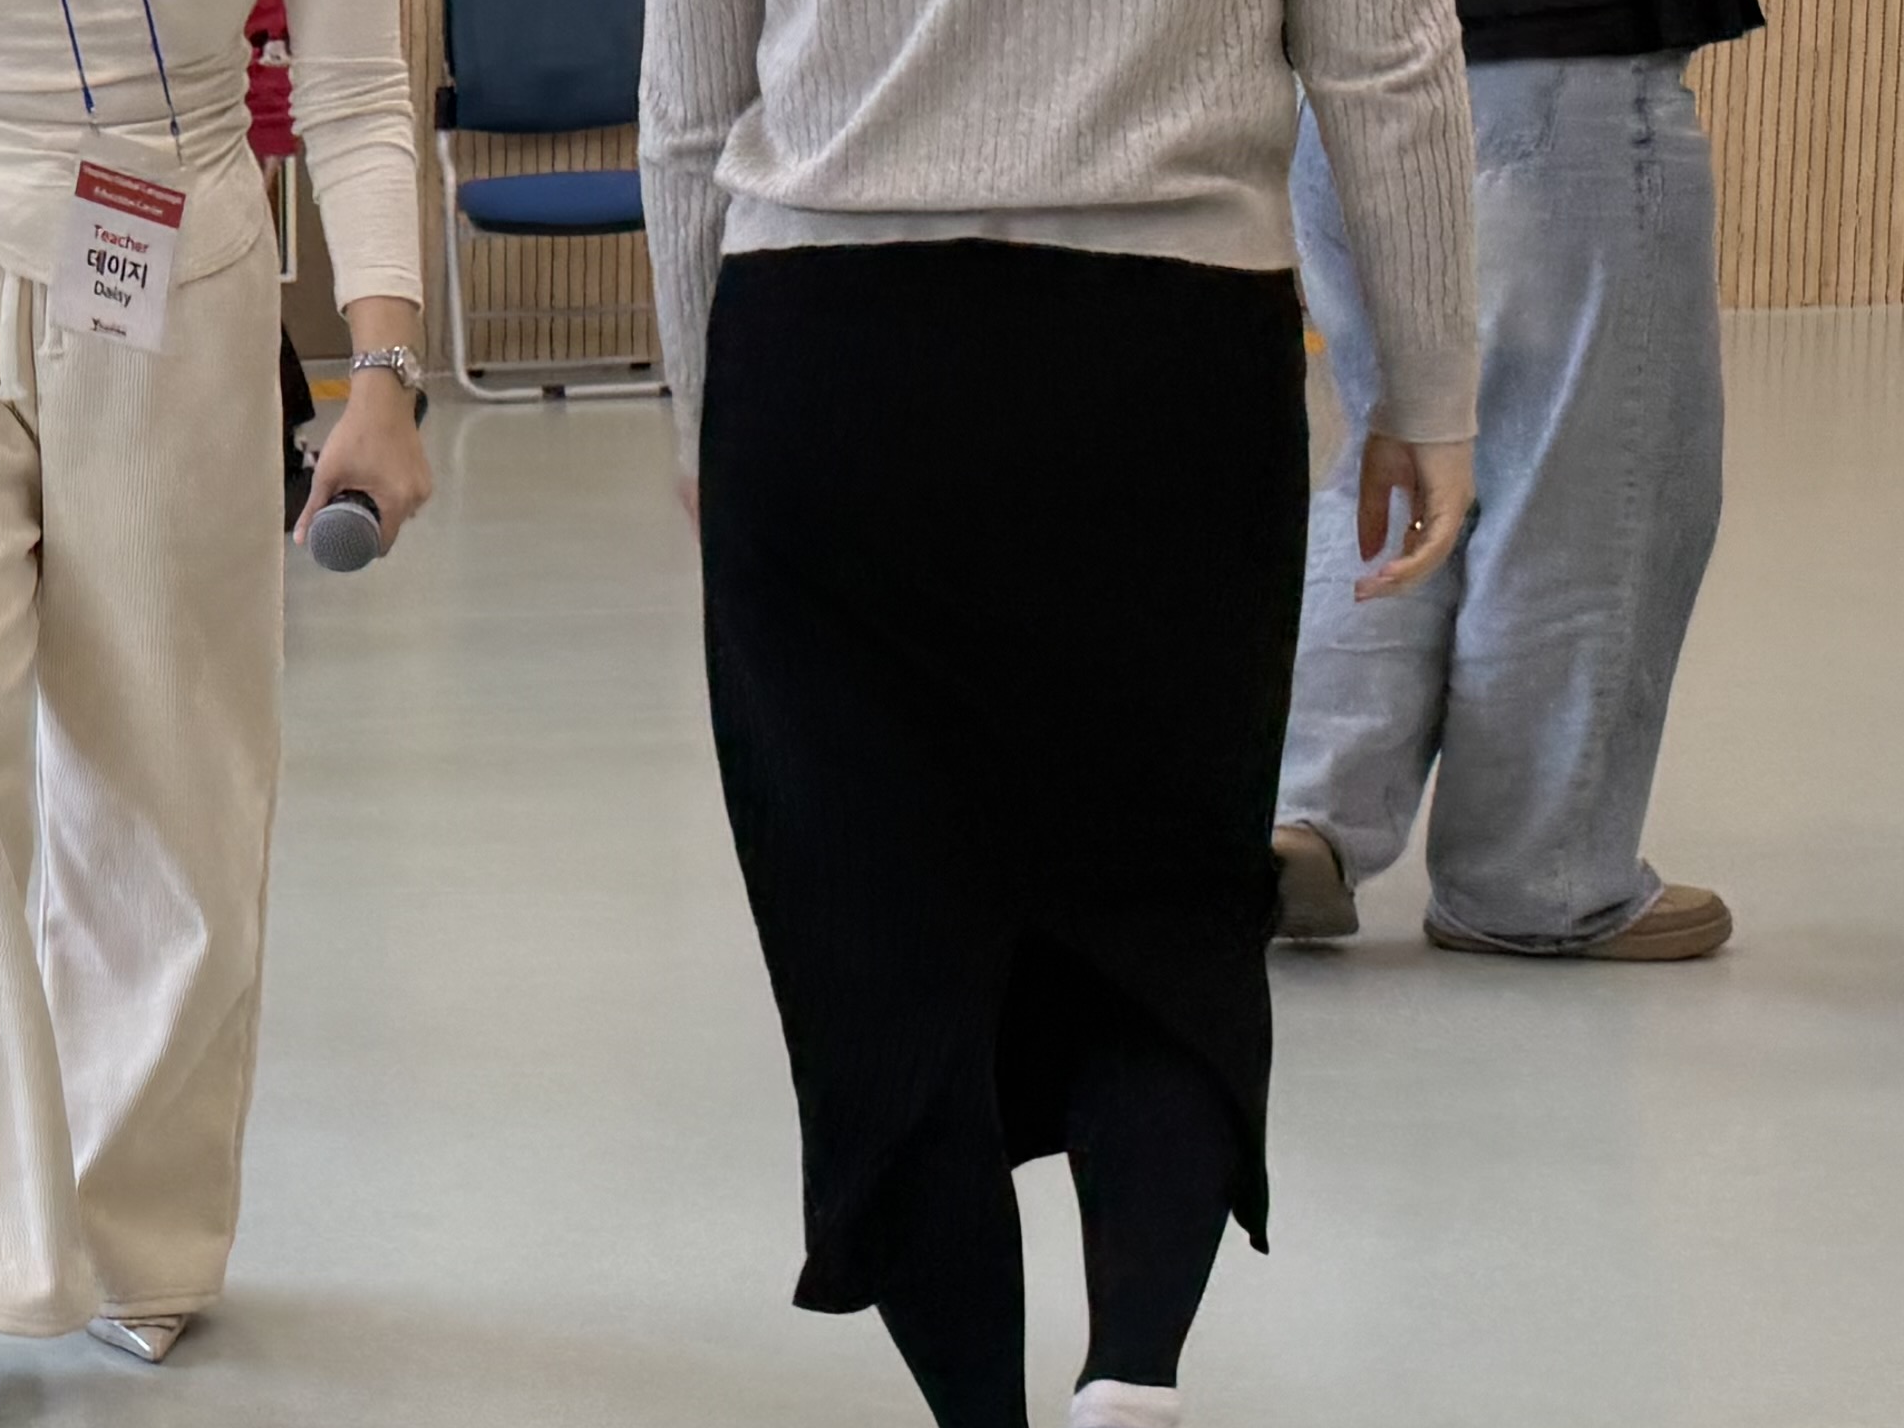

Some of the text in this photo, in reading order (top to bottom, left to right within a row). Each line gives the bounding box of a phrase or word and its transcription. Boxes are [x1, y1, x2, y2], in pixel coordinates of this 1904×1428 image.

[95, 224, 149, 253] Teacher
[87, 248, 148, 289] 데이지
[94, 280, 132, 308] Daisy
